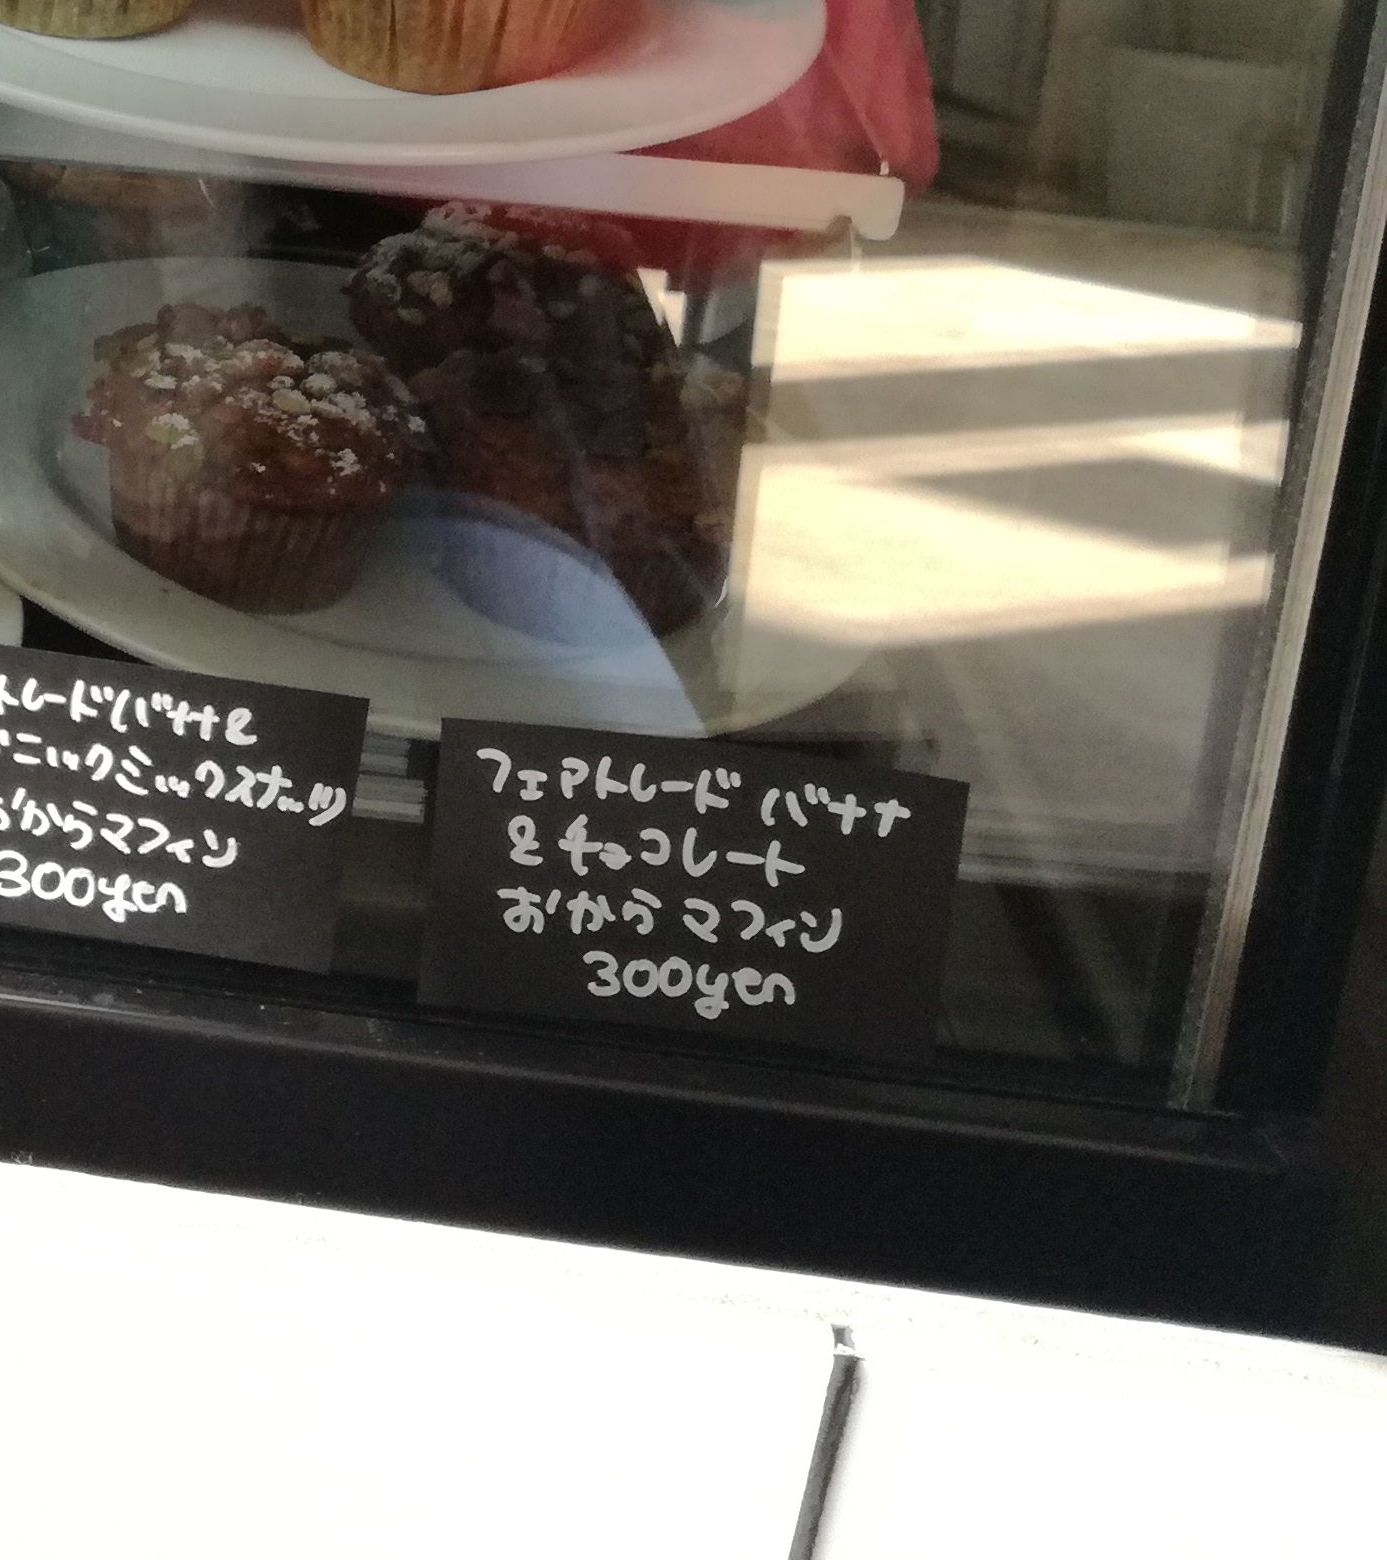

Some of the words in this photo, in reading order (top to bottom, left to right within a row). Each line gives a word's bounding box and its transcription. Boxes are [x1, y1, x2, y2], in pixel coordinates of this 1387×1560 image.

[495, 886, 843, 953] おからマフィン
[581, 949, 797, 1021] 300yen
